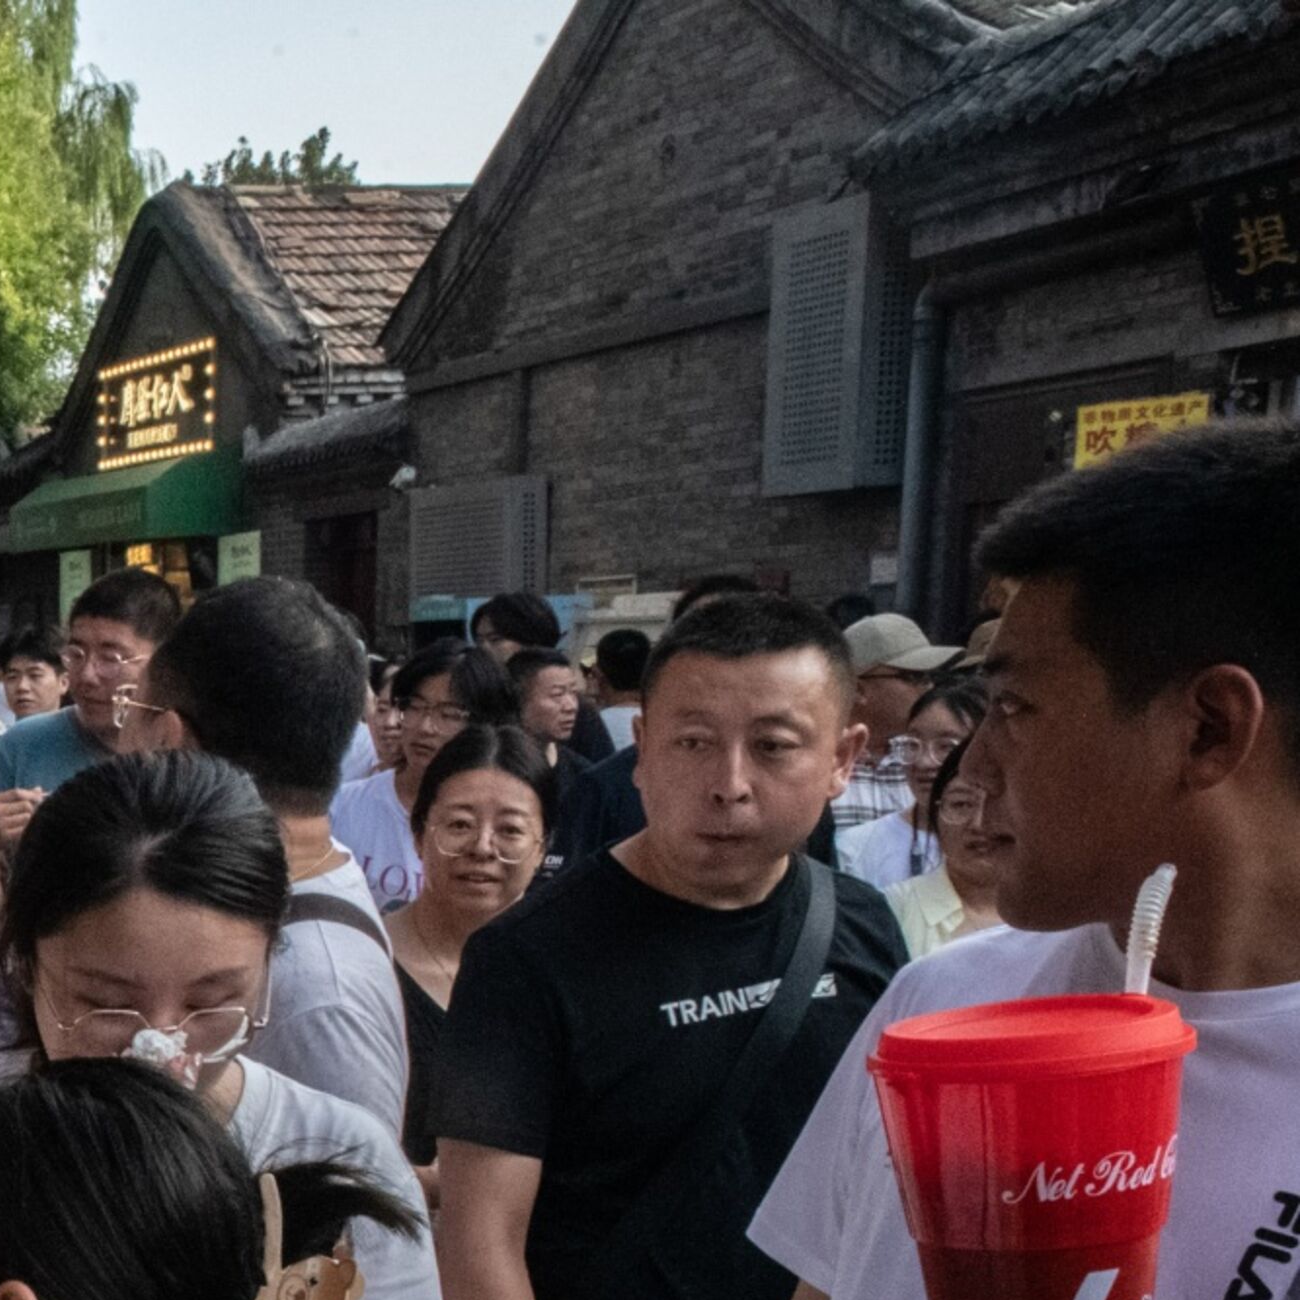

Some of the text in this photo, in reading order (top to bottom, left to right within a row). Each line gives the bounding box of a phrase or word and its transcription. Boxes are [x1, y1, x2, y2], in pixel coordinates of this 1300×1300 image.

[1233, 212, 1298, 278] 捏
[1002, 1163, 1084, 1205] Net
[1084, 1148, 1162, 1197] Red
